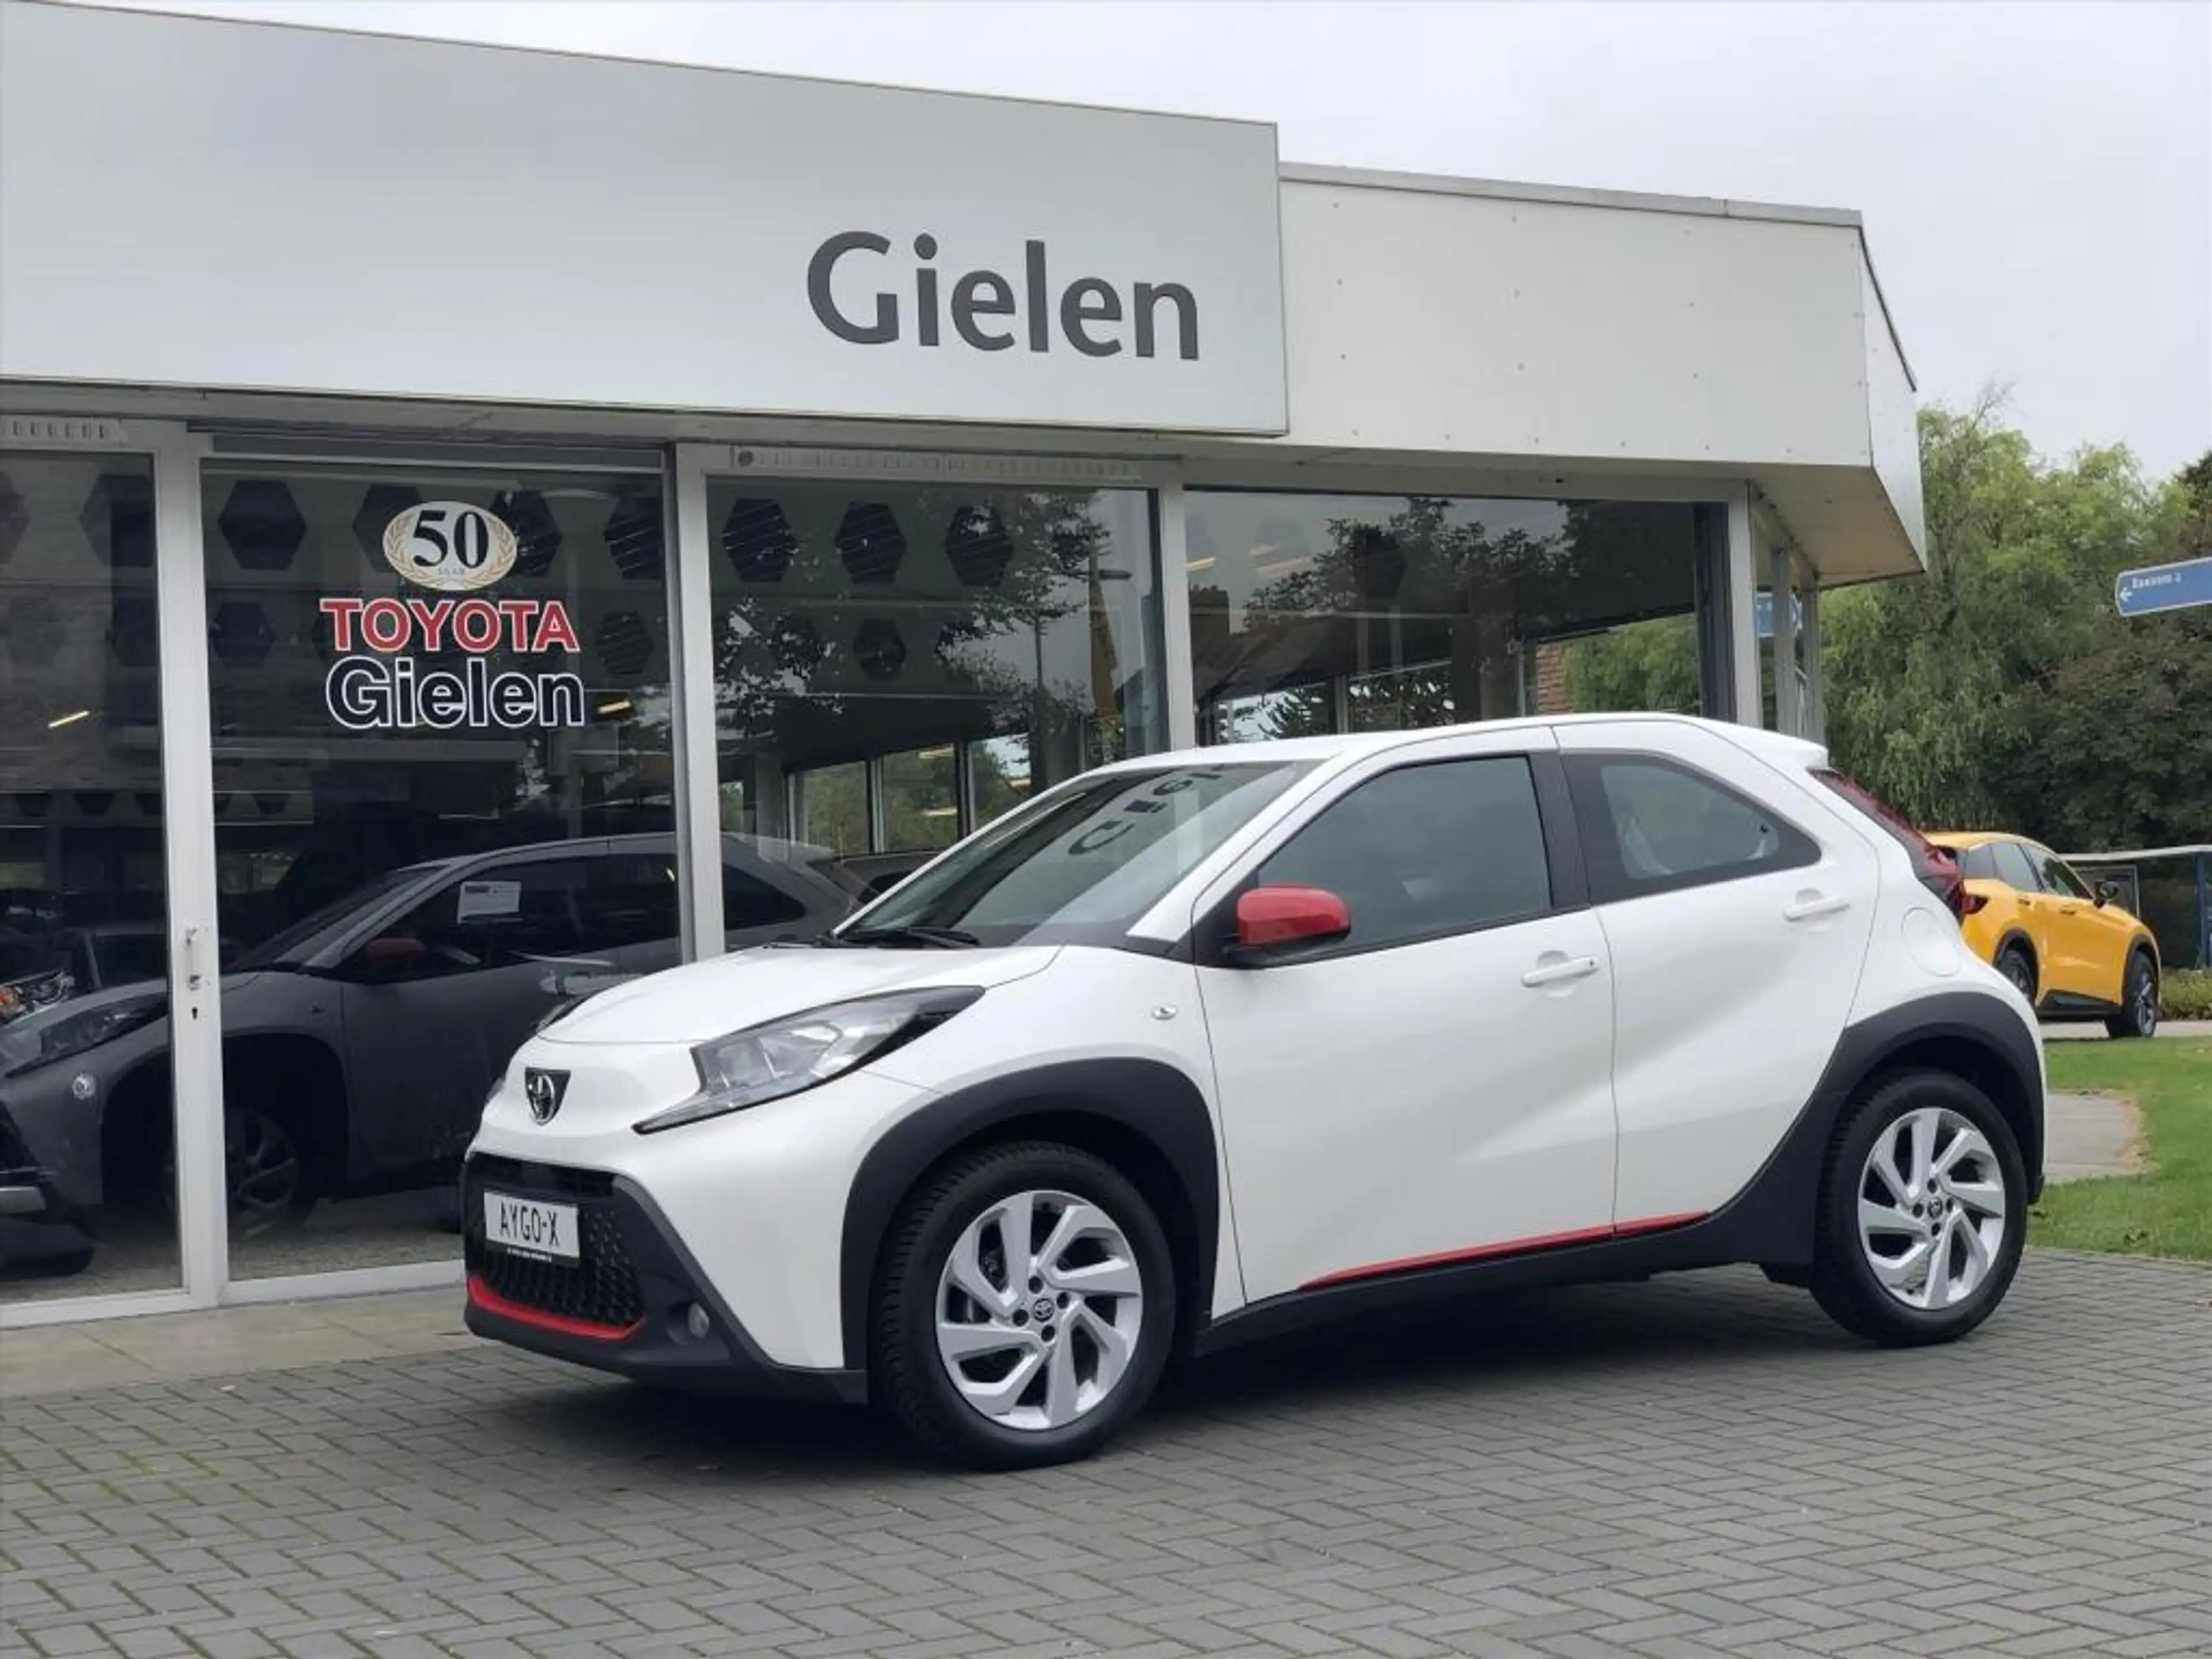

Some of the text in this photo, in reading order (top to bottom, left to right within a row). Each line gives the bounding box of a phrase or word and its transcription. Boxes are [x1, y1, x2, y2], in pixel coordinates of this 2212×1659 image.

[807, 231, 1199, 361] Gielen
[413, 510, 488, 569] 50
[320, 597, 581, 652] TOYOTA
[325, 655, 585, 729] Gielen
[499, 1202, 560, 1247] AYGO-X
